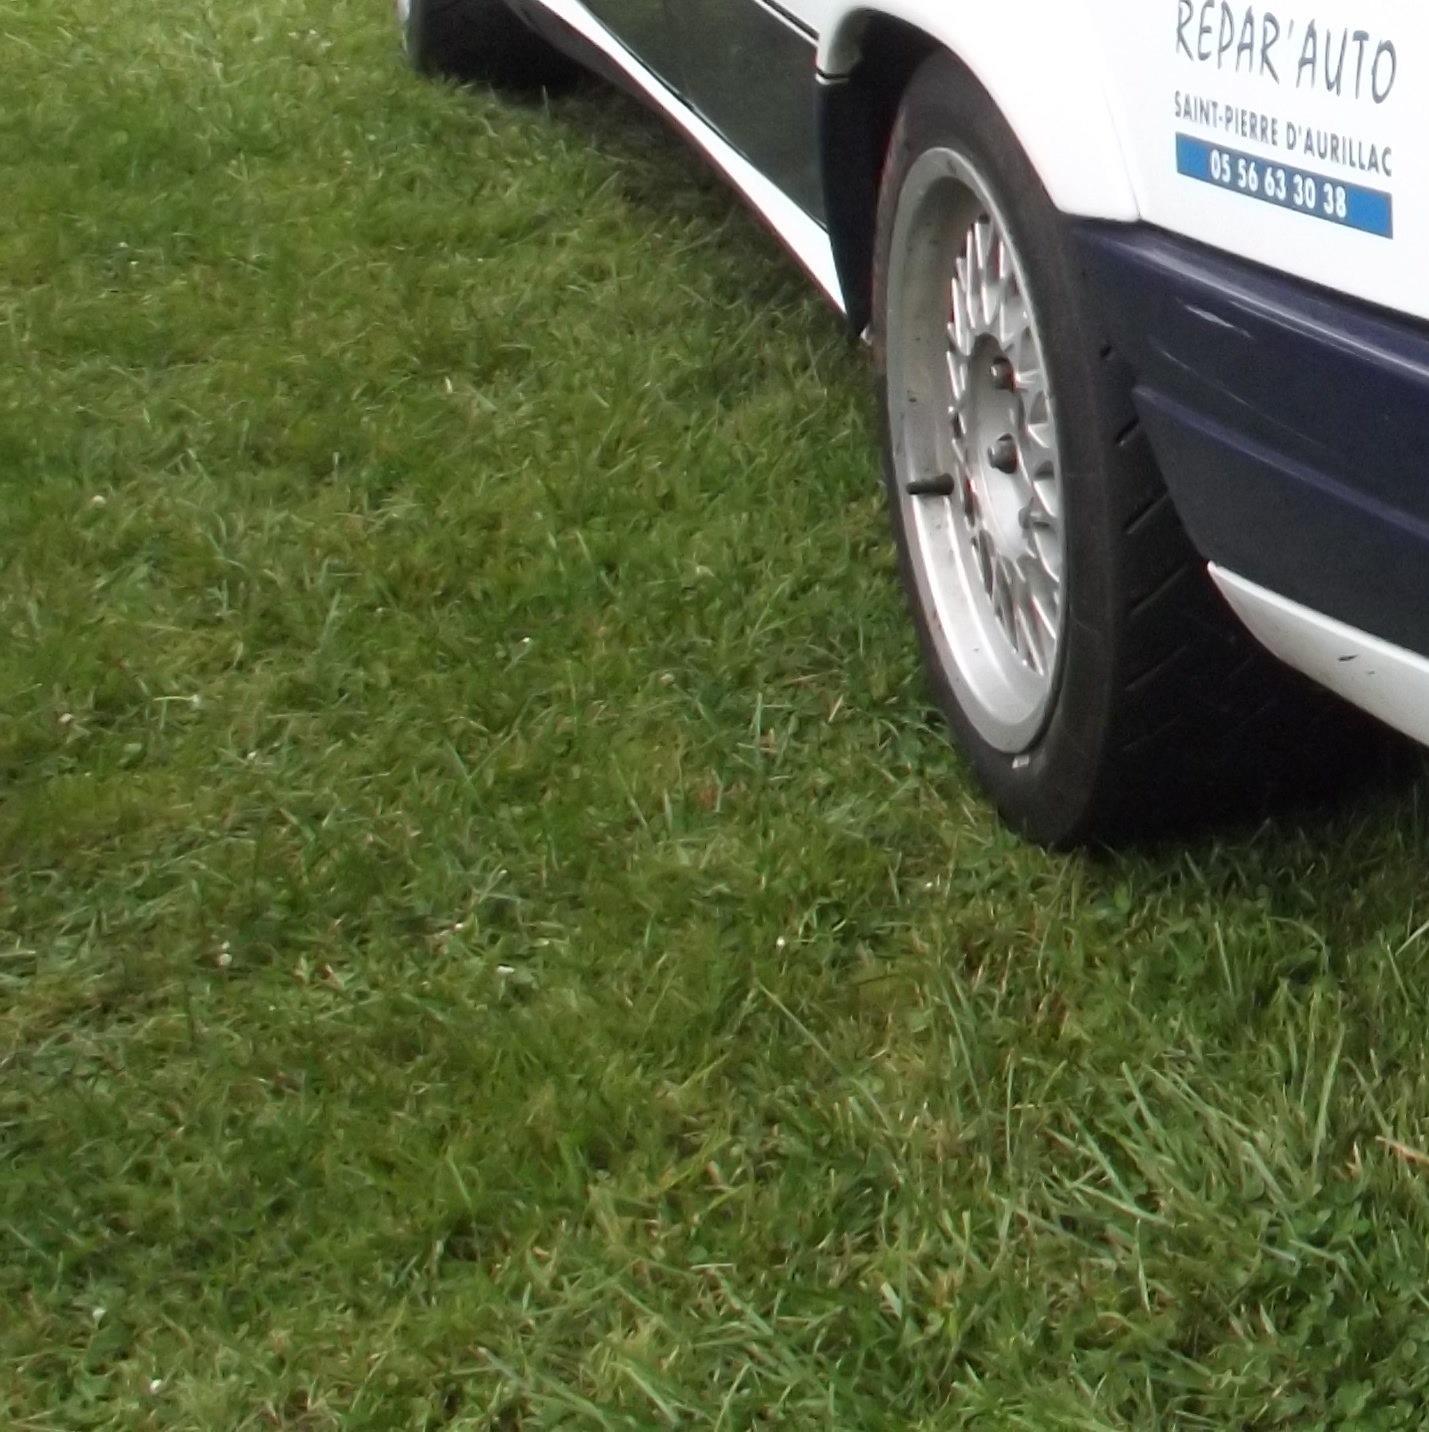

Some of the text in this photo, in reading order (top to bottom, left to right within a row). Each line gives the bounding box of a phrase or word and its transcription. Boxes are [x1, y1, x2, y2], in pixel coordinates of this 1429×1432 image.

[1174, 90, 1393, 178] SAINT-PIERRE D'AURILLAC
[1210, 149, 1347, 219] 05 56 63 30 38
